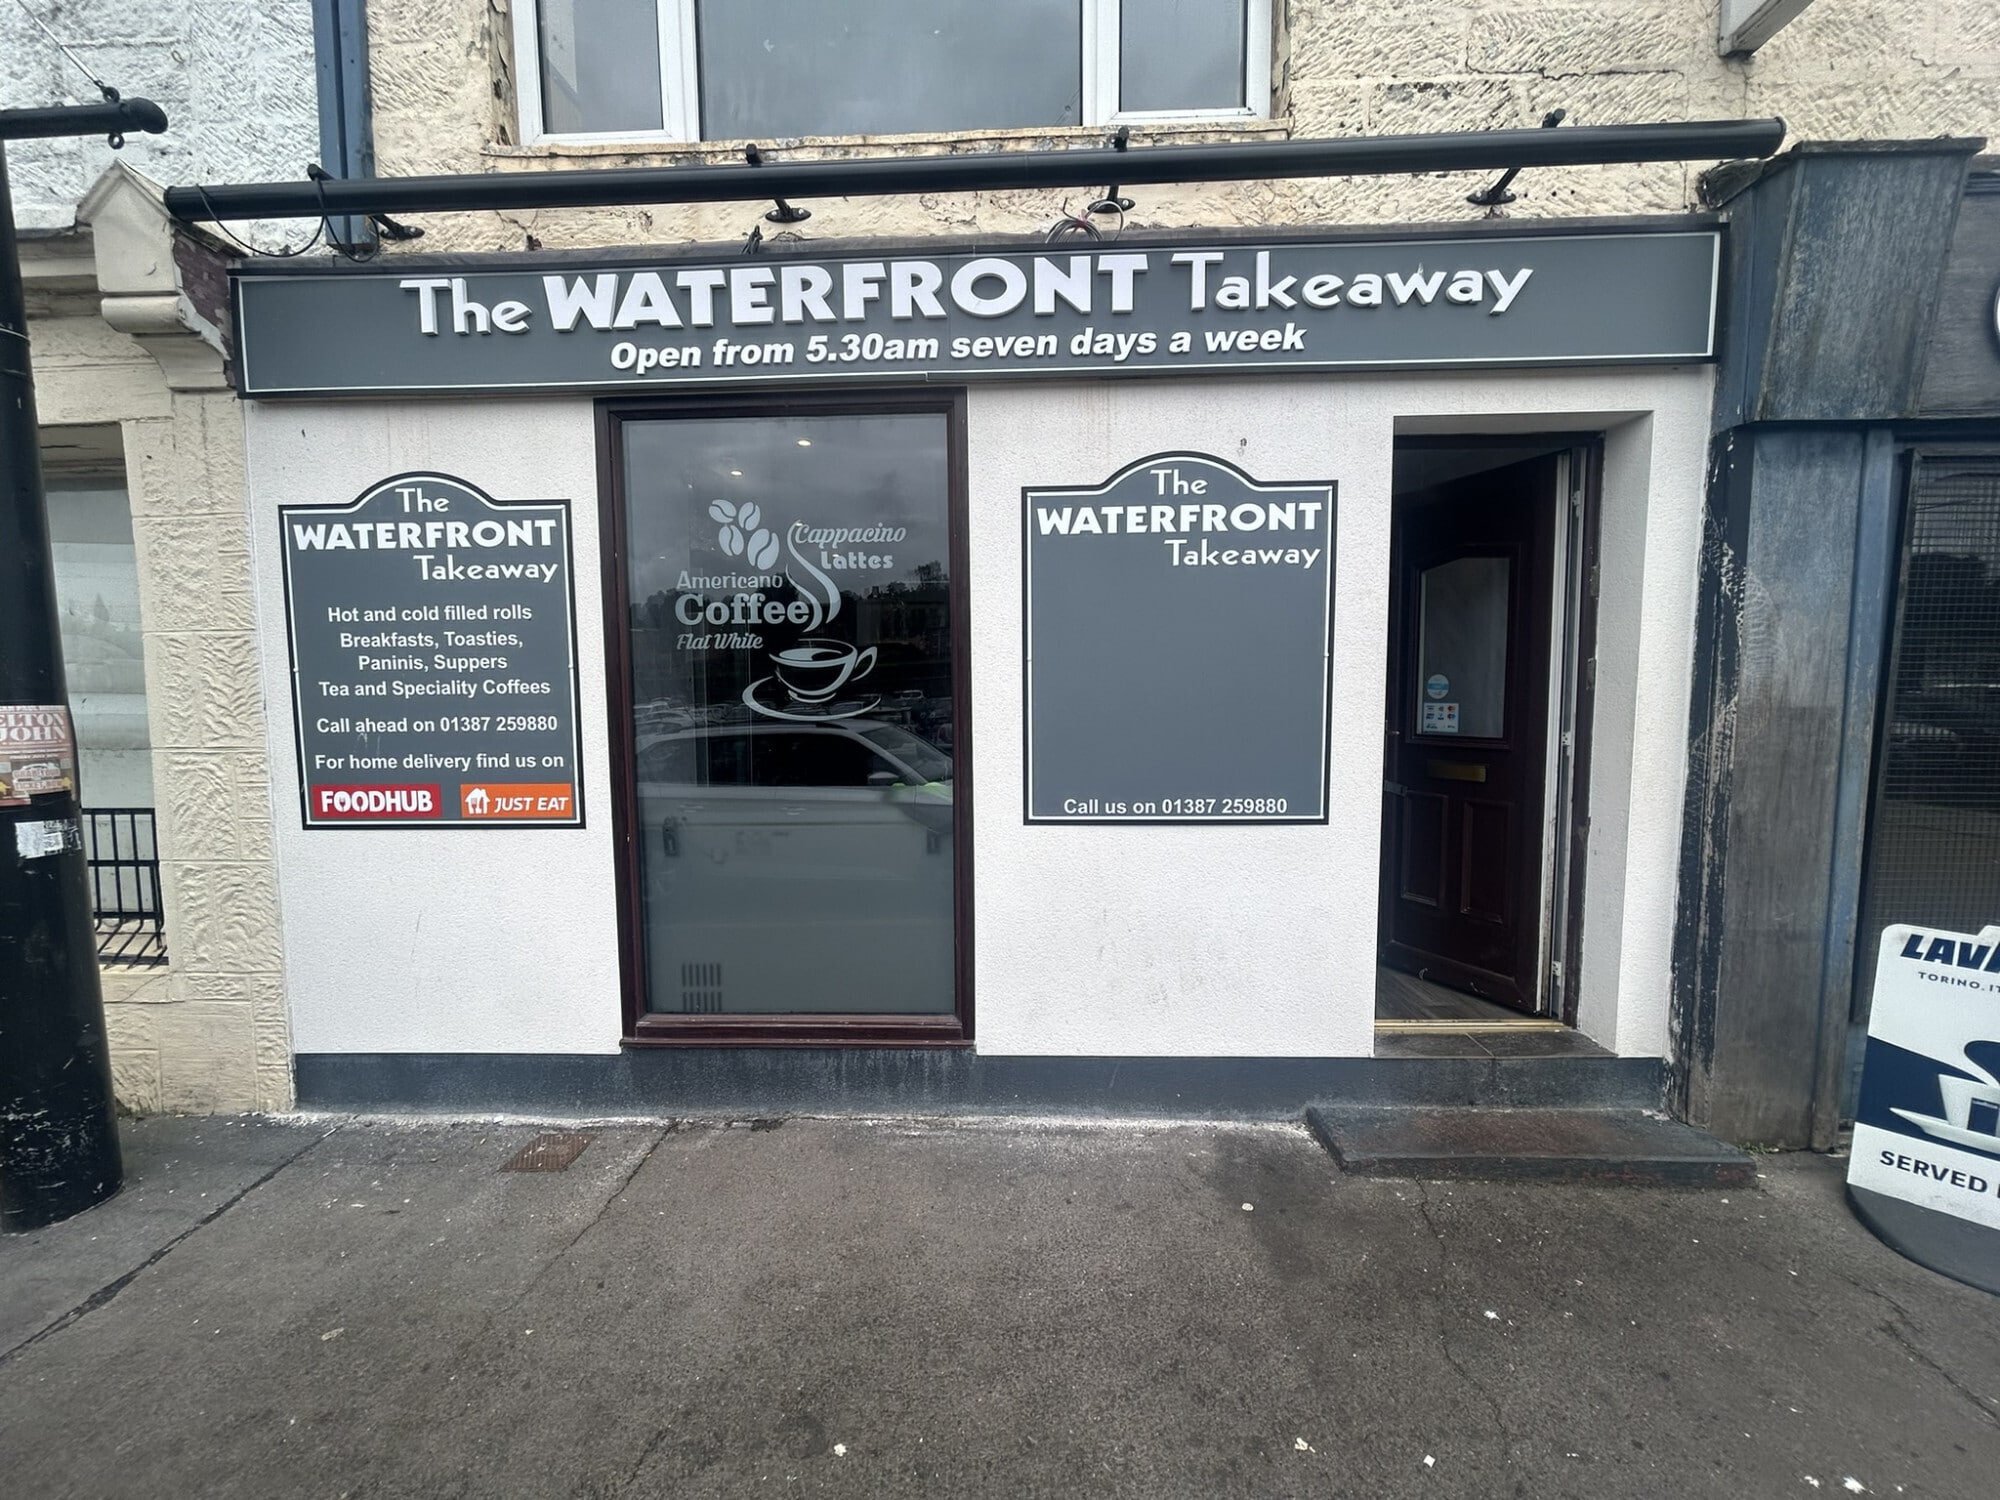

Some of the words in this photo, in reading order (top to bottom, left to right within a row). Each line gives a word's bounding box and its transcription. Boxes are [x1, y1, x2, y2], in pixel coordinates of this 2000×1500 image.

[397, 275, 533, 336] The
[542, 252, 1149, 333] WATERFRONT
[1171, 250, 1534, 315] Takeaway
[610, 342, 702, 375] Open
[712, 339, 795, 366] from
[805, 333, 939, 363] 5.30am
[950, 334, 1058, 358] seven
[1070, 327, 1157, 361] days
[1169, 331, 1192, 354] a
[1204, 322, 1308, 352] week
[1149, 468, 1208, 496] The
[394, 487, 450, 513] The
[1036, 502, 1322, 536] WATERFRONT
[292, 519, 557, 551] WATERFRONT
[795, 521, 906, 549] Cappacino
[1163, 538, 1321, 569] Takeaway
[412, 554, 559, 583] Takeaway
[676, 570, 783, 590] Americano
[327, 606, 360, 622] Hot
[363, 606, 397, 622] and
[401, 605, 440, 622] cold
[443, 604, 488, 621] filled
[493, 603, 533, 620] rolls
[675, 592, 810, 626] Coffee
[340, 631, 439, 650] Breakfasts,
[443, 630, 524, 648] Toasties,
[676, 632, 712, 650] Flat
[713, 632, 764, 650] White
[358, 654, 429, 673] Paninis,
[433, 654, 508, 674] Suppers
[318, 681, 350, 697] Tea
[354, 680, 387, 697] and
[391, 679, 478, 699] Speciality
[482, 678, 551, 695] Coffees
[316, 717, 350, 733] Call
[355, 717, 408, 733] ahead
[412, 720, 435, 733] on
[439, 716, 491, 732] 01387
[496, 715, 558, 732] 259880
[314, 754, 345, 770] For
[349, 754, 398, 770] home
[402, 753, 472, 772] delivery
[475, 752, 510, 768] find
[515, 756, 537, 768] us
[541, 756, 564, 768] on
[320, 790, 433, 813] FOODHUB
[494, 797, 534, 814] JUST
[537, 796, 570, 811] EAT
[1063, 798, 1099, 815] Call
[1104, 802, 1127, 815] us
[1132, 802, 1156, 814] on
[1161, 798, 1217, 814] 01387
[1221, 798, 1288, 814] 259880
[1880, 1150, 1988, 1193] SERVED
